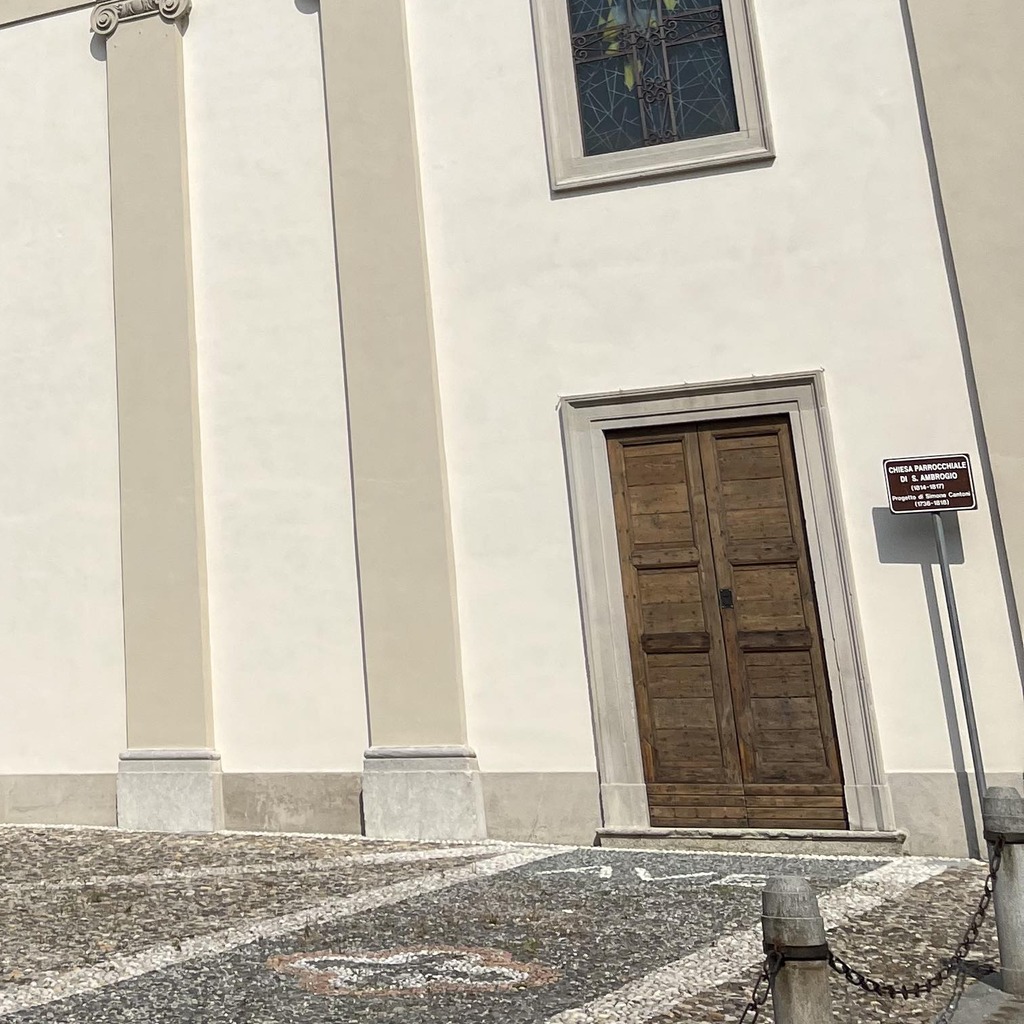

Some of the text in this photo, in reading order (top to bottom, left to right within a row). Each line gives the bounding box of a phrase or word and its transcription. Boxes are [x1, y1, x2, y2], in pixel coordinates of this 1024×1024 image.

[888, 461, 967, 474] CHIESA PARROCCHIALE
[900, 472, 958, 483] DI S. AMBROGIO
[892, 494, 917, 502] Progetto
